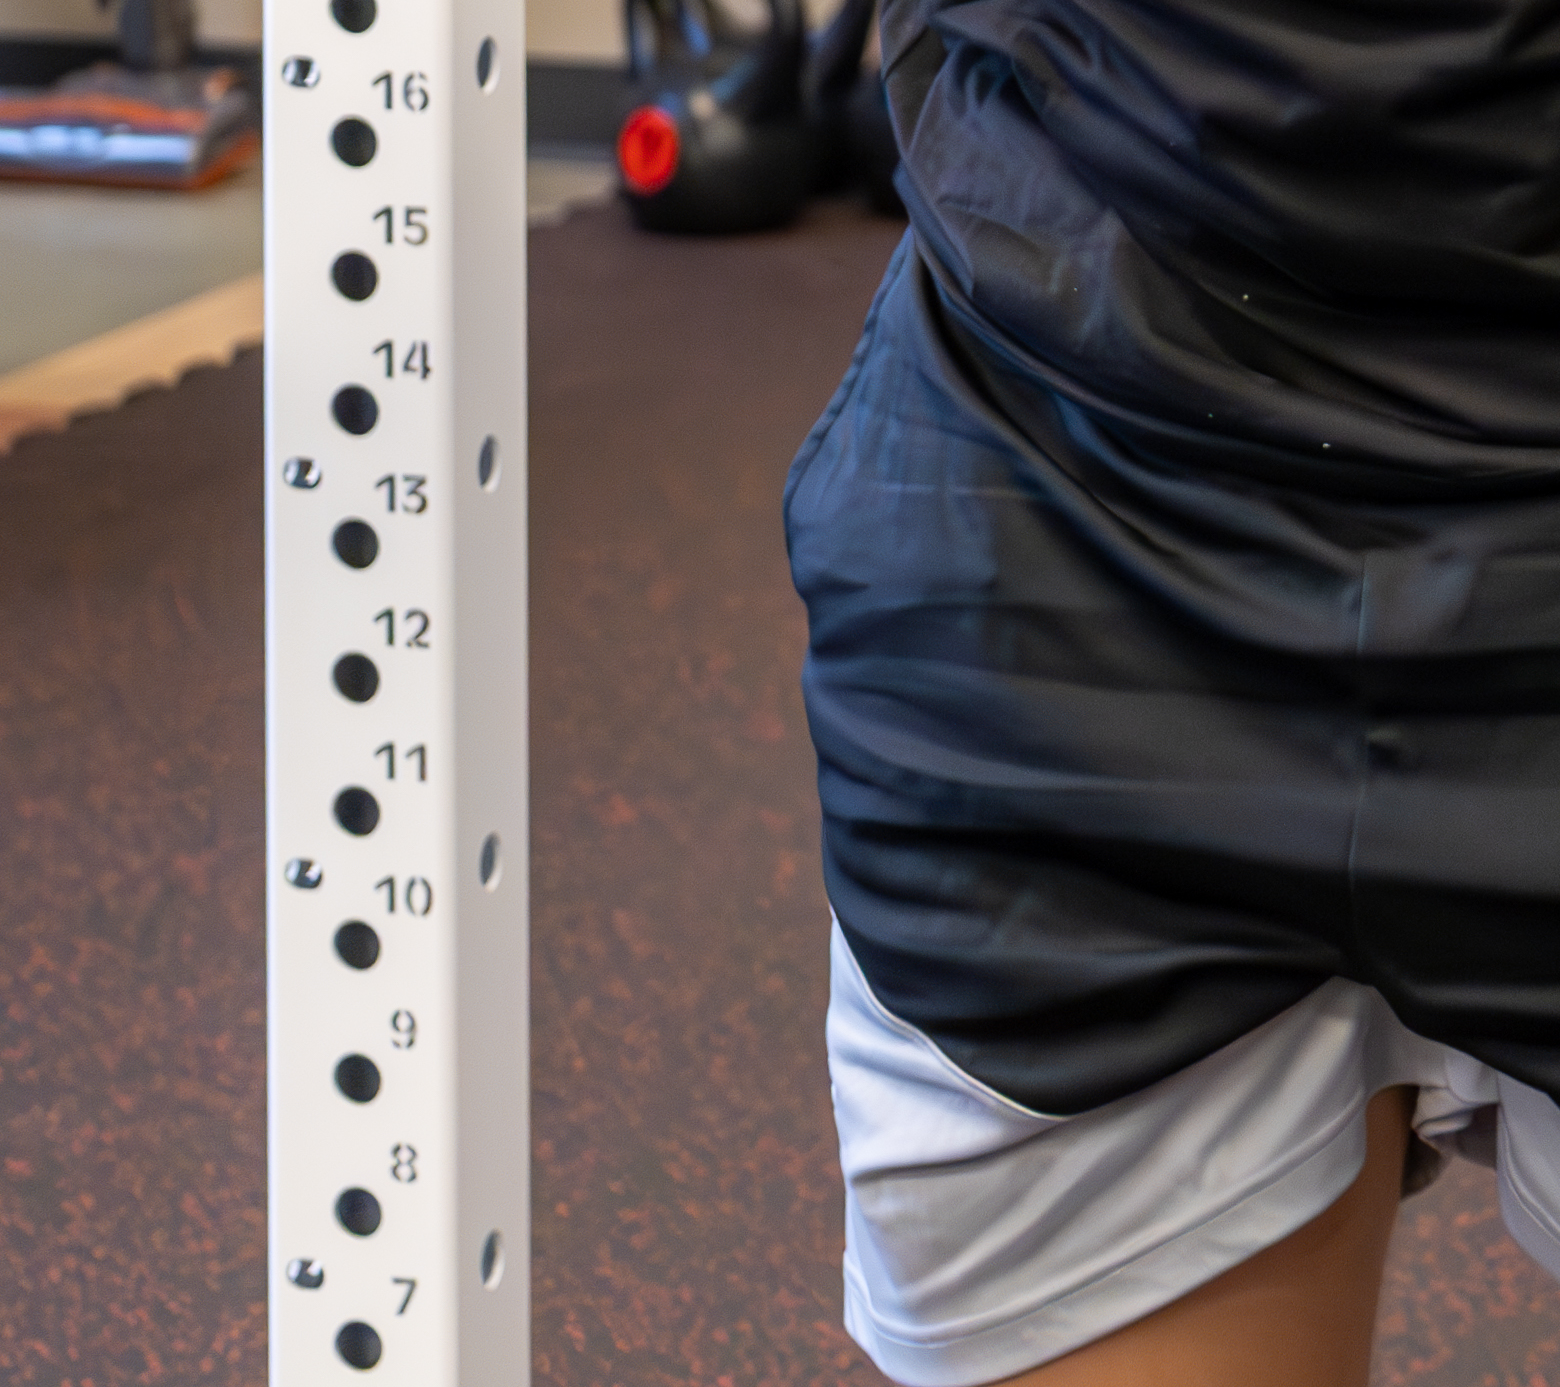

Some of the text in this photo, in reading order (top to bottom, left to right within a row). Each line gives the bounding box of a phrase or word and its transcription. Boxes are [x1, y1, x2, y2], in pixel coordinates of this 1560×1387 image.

[370, 69, 431, 113] 16
[371, 204, 430, 247] 15
[371, 338, 433, 382] 14
[373, 472, 429, 516] 13
[372, 606, 432, 650] 12
[373, 740, 428, 784] 11
[373, 874, 435, 918] 10
[389, 1008, 418, 1051] 9
[389, 1142, 419, 1184] 8
[390, 1276, 419, 1317] 7
